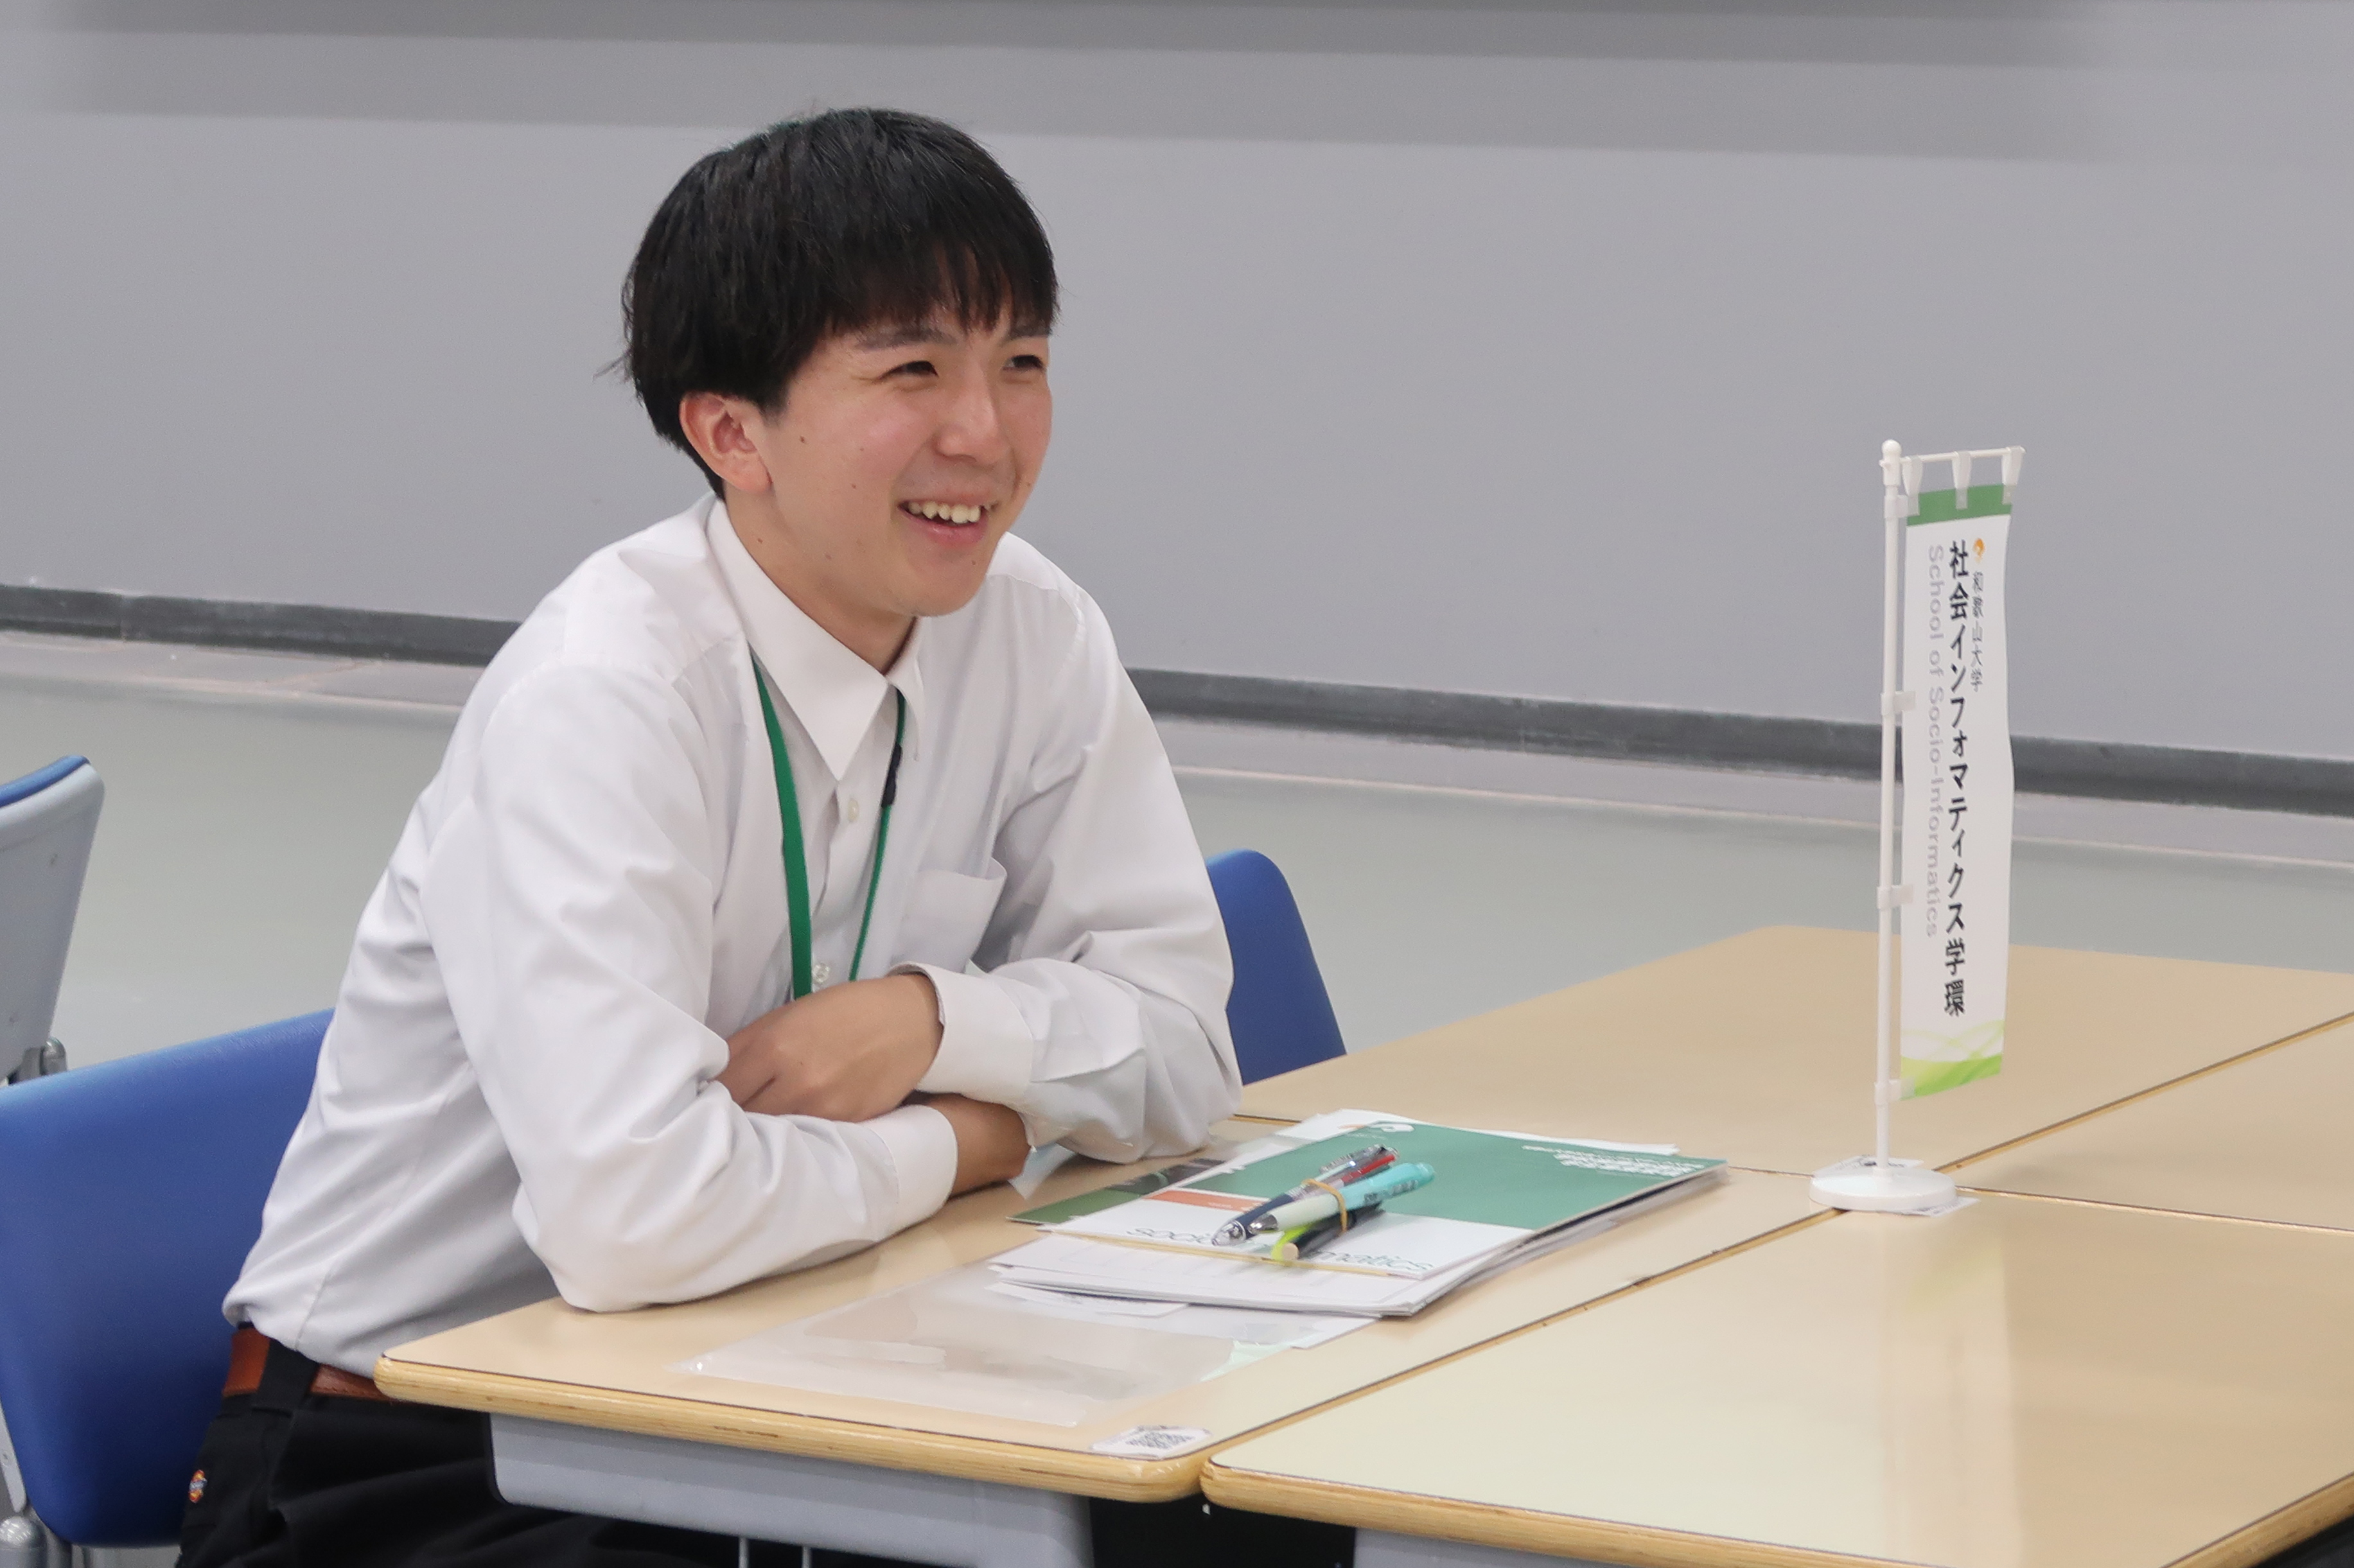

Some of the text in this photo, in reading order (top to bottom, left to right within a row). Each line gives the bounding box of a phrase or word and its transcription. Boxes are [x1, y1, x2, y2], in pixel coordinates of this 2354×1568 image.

[1926, 545, 1945, 938] School of Socio-Informatics
